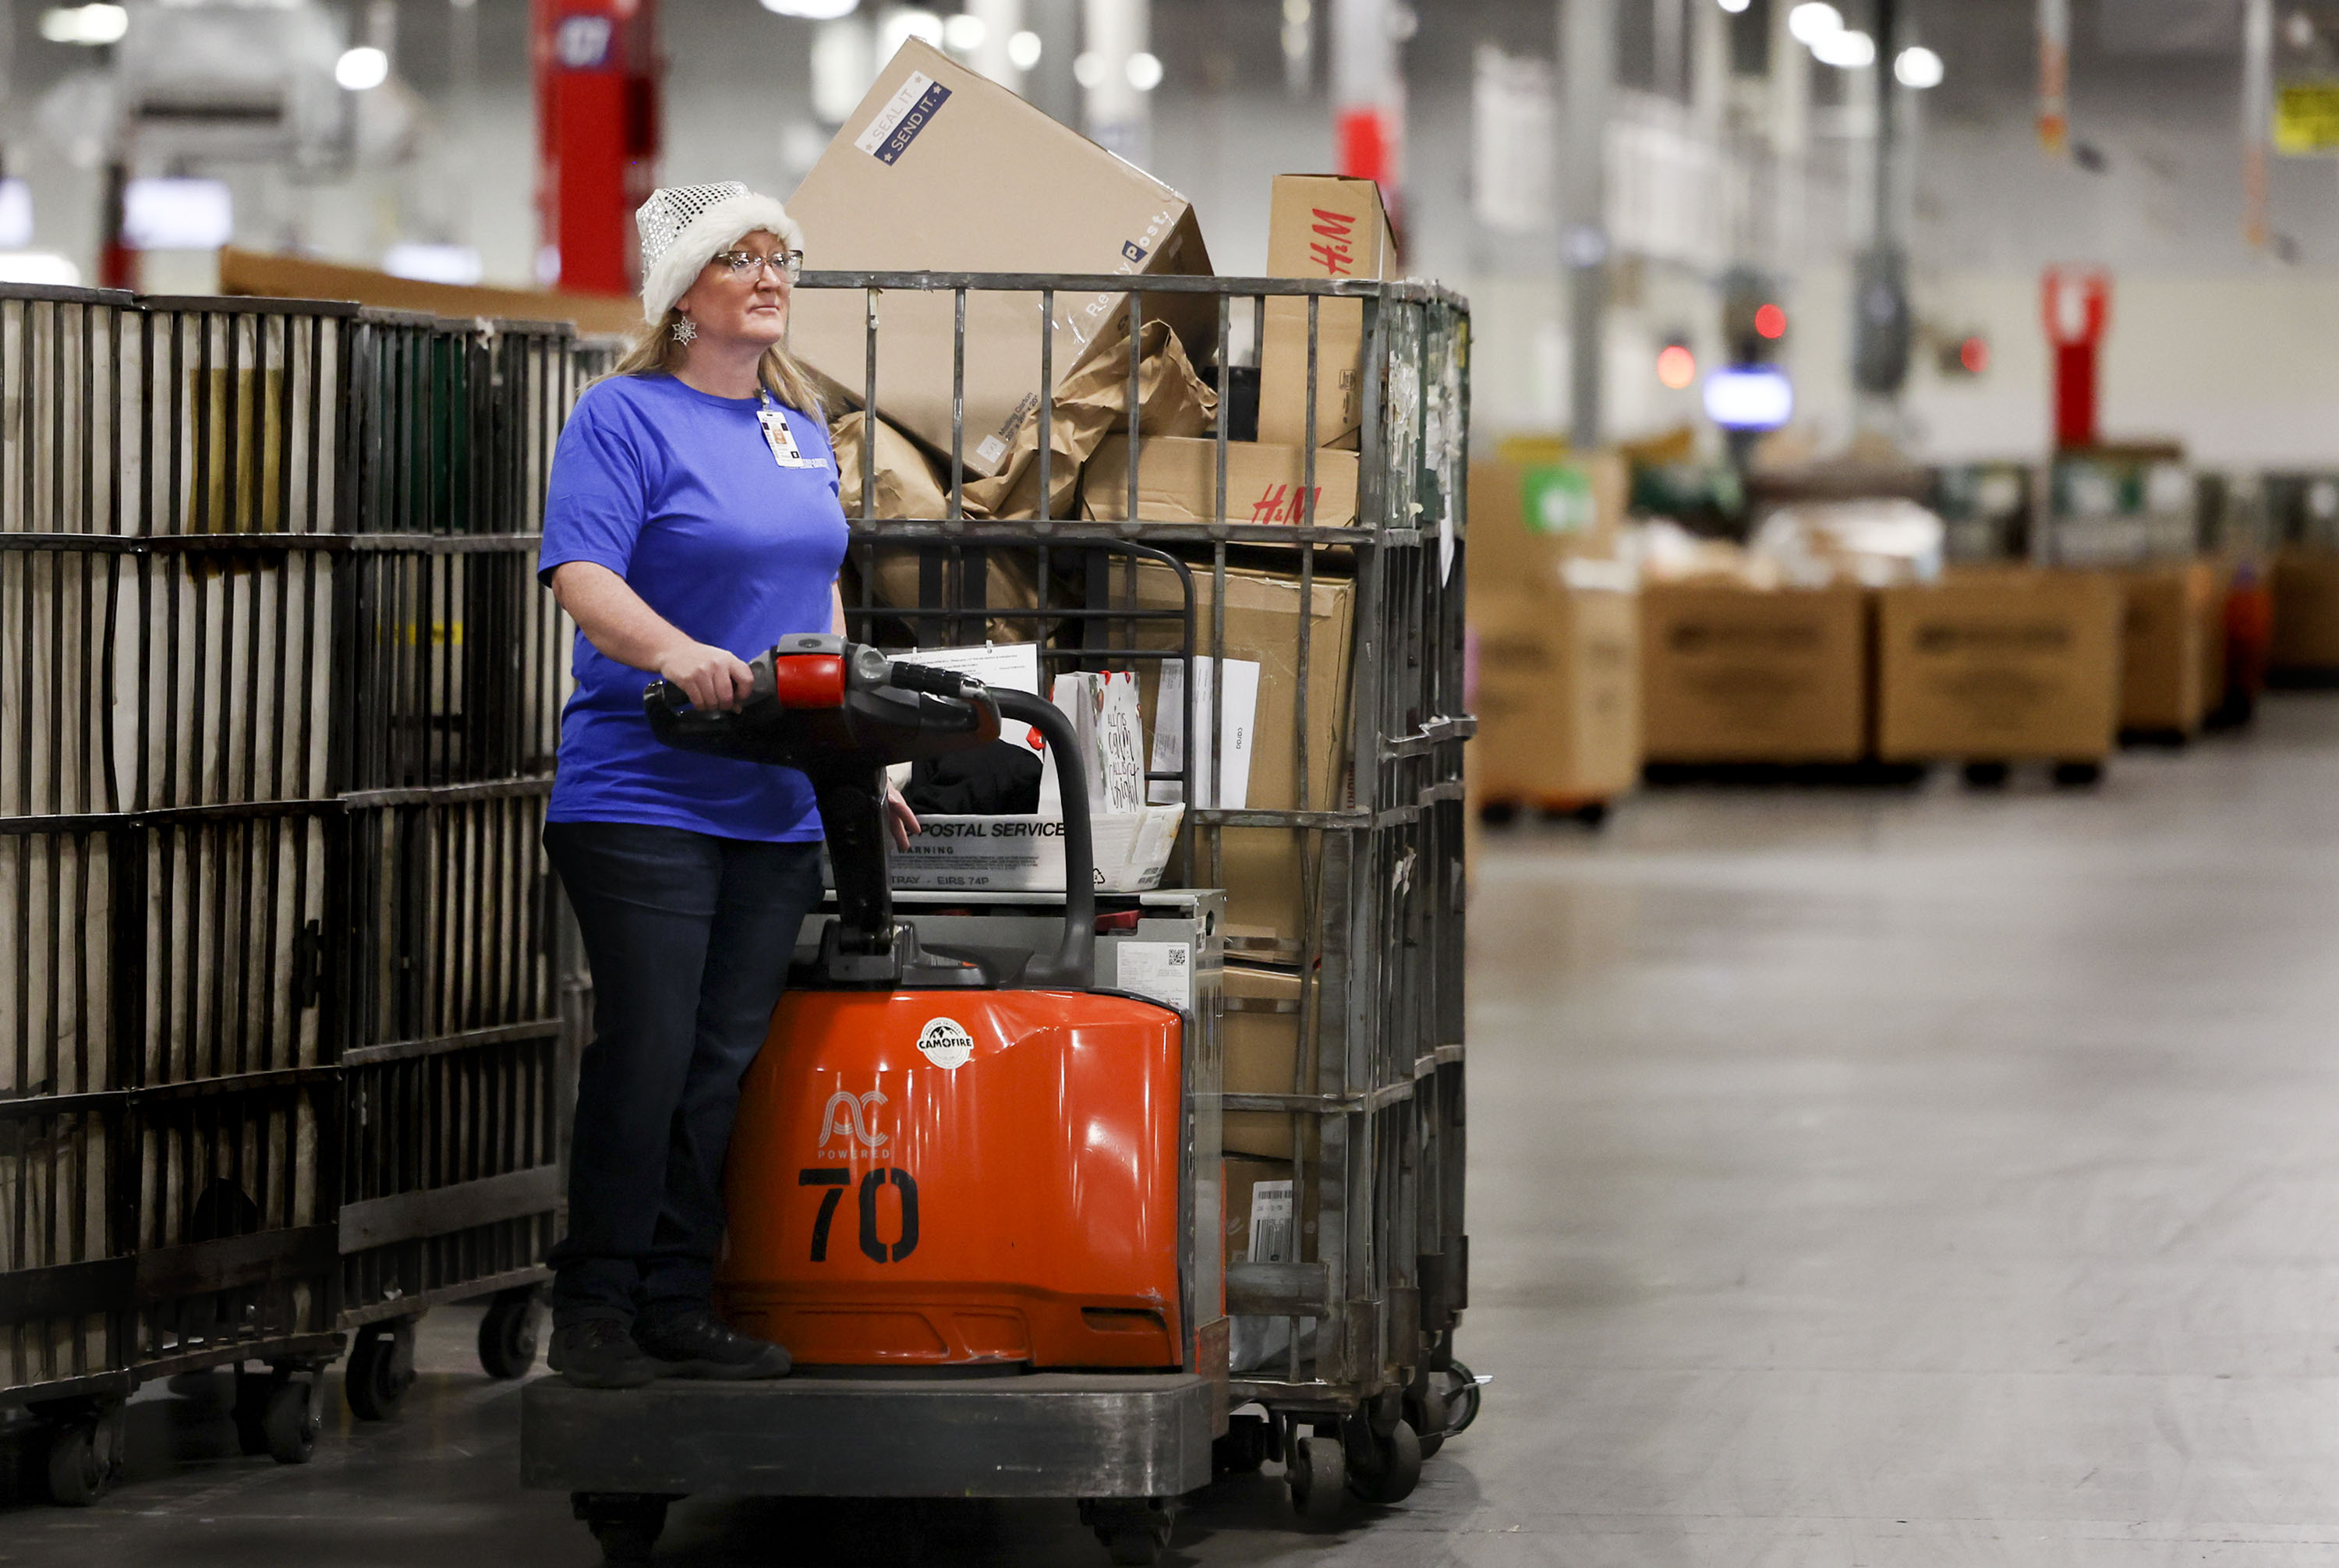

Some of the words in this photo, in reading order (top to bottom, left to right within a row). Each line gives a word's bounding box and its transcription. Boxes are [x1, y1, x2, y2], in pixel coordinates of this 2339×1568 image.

[872, 108, 904, 140] SEAL
[891, 113, 923, 151] SEND
[918, 97, 937, 113] IT.
[1310, 208, 1356, 275] H&M
[1086, 214, 1168, 317] ReyPost
[1015, 392, 1032, 413] Carton
[1251, 483, 1322, 525] H&M
[918, 823, 986, 837] POSTAL
[991, 822, 1066, 837] SERVICE
[891, 876, 920, 884] TRAY
[968, 877, 989, 886] 74P
[918, 1038, 972, 1049] CAMOFIRE
[819, 1091, 889, 1148] AC
[819, 1149, 890, 1159] POWERED
[798, 1167, 919, 1264] 70
